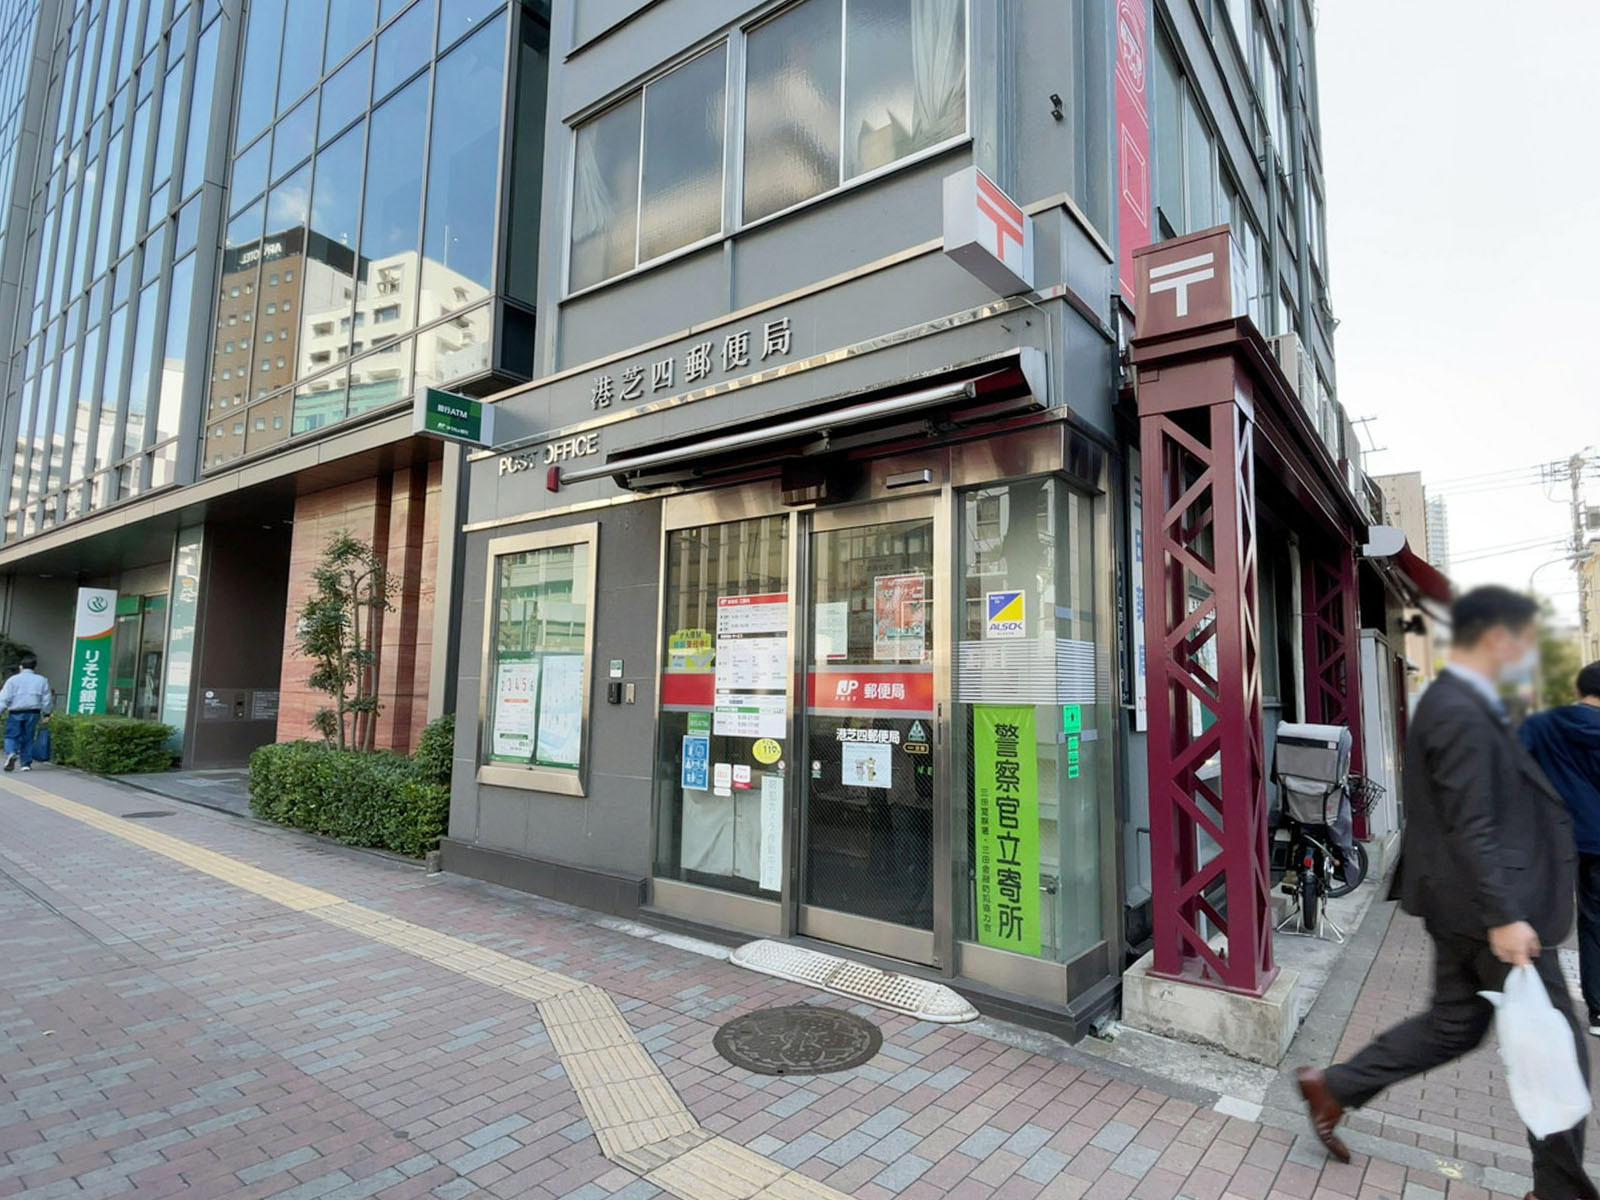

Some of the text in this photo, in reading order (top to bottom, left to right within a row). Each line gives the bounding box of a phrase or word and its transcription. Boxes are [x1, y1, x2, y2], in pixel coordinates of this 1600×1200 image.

[590, 316, 792, 410] 港芝四郵便局
[498, 433, 599, 476] POST OFFICE
[989, 622, 1023, 631] ALSOK
[78, 650, 100, 715] りそな銀行
[864, 683, 905, 700] 郵便局
[836, 728, 900, 745] 港芝四郵便局
[994, 723, 1023, 942] 警察官立寄所
